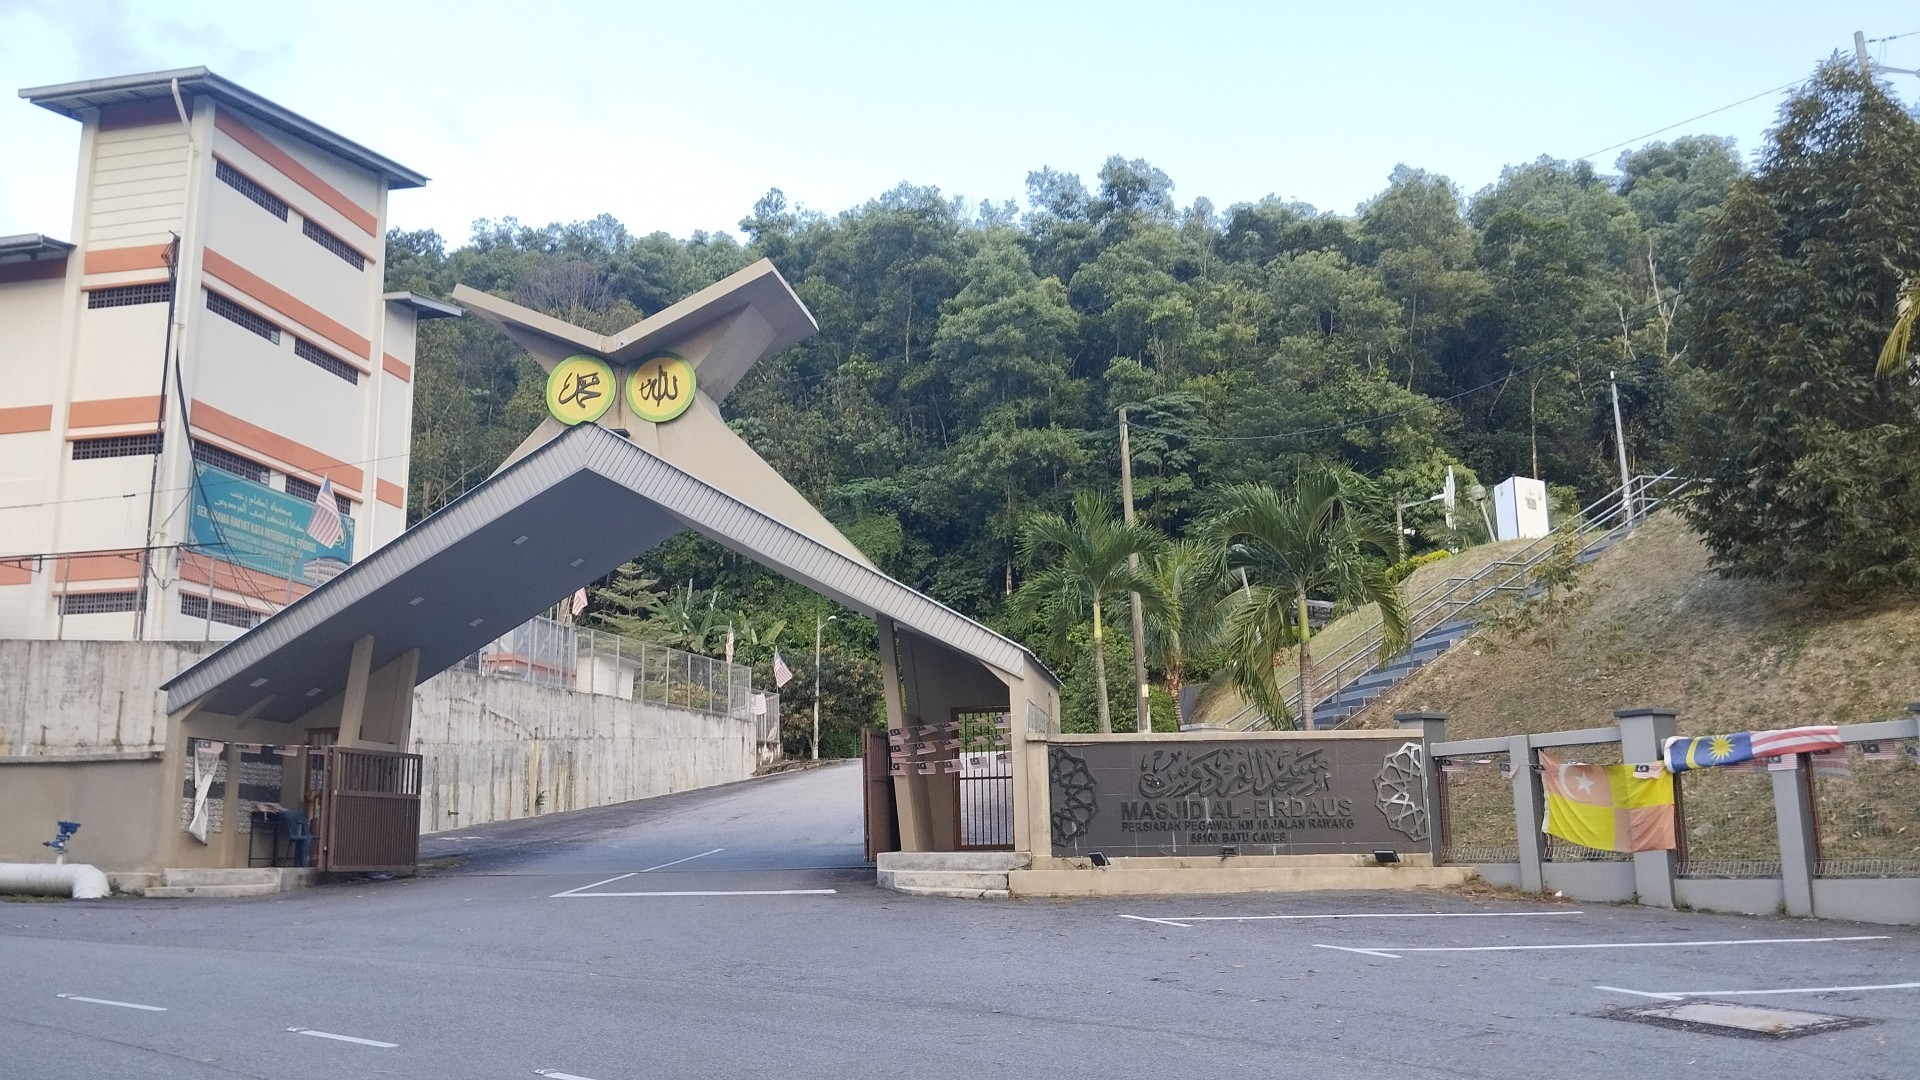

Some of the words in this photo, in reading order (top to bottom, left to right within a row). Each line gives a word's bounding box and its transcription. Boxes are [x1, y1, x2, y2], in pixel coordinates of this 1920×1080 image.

[639, 363, 678, 407] الله
[1120, 801, 1205, 820] MASJID
[1121, 820, 1181, 832] PERSIARAN
[1239, 819, 1254, 830] KM
[1271, 818, 1306, 830] JALAN
[1308, 818, 1354, 830] RAWANG
[1222, 832, 1249, 844] BATU
[1252, 831, 1286, 843] CAVES
